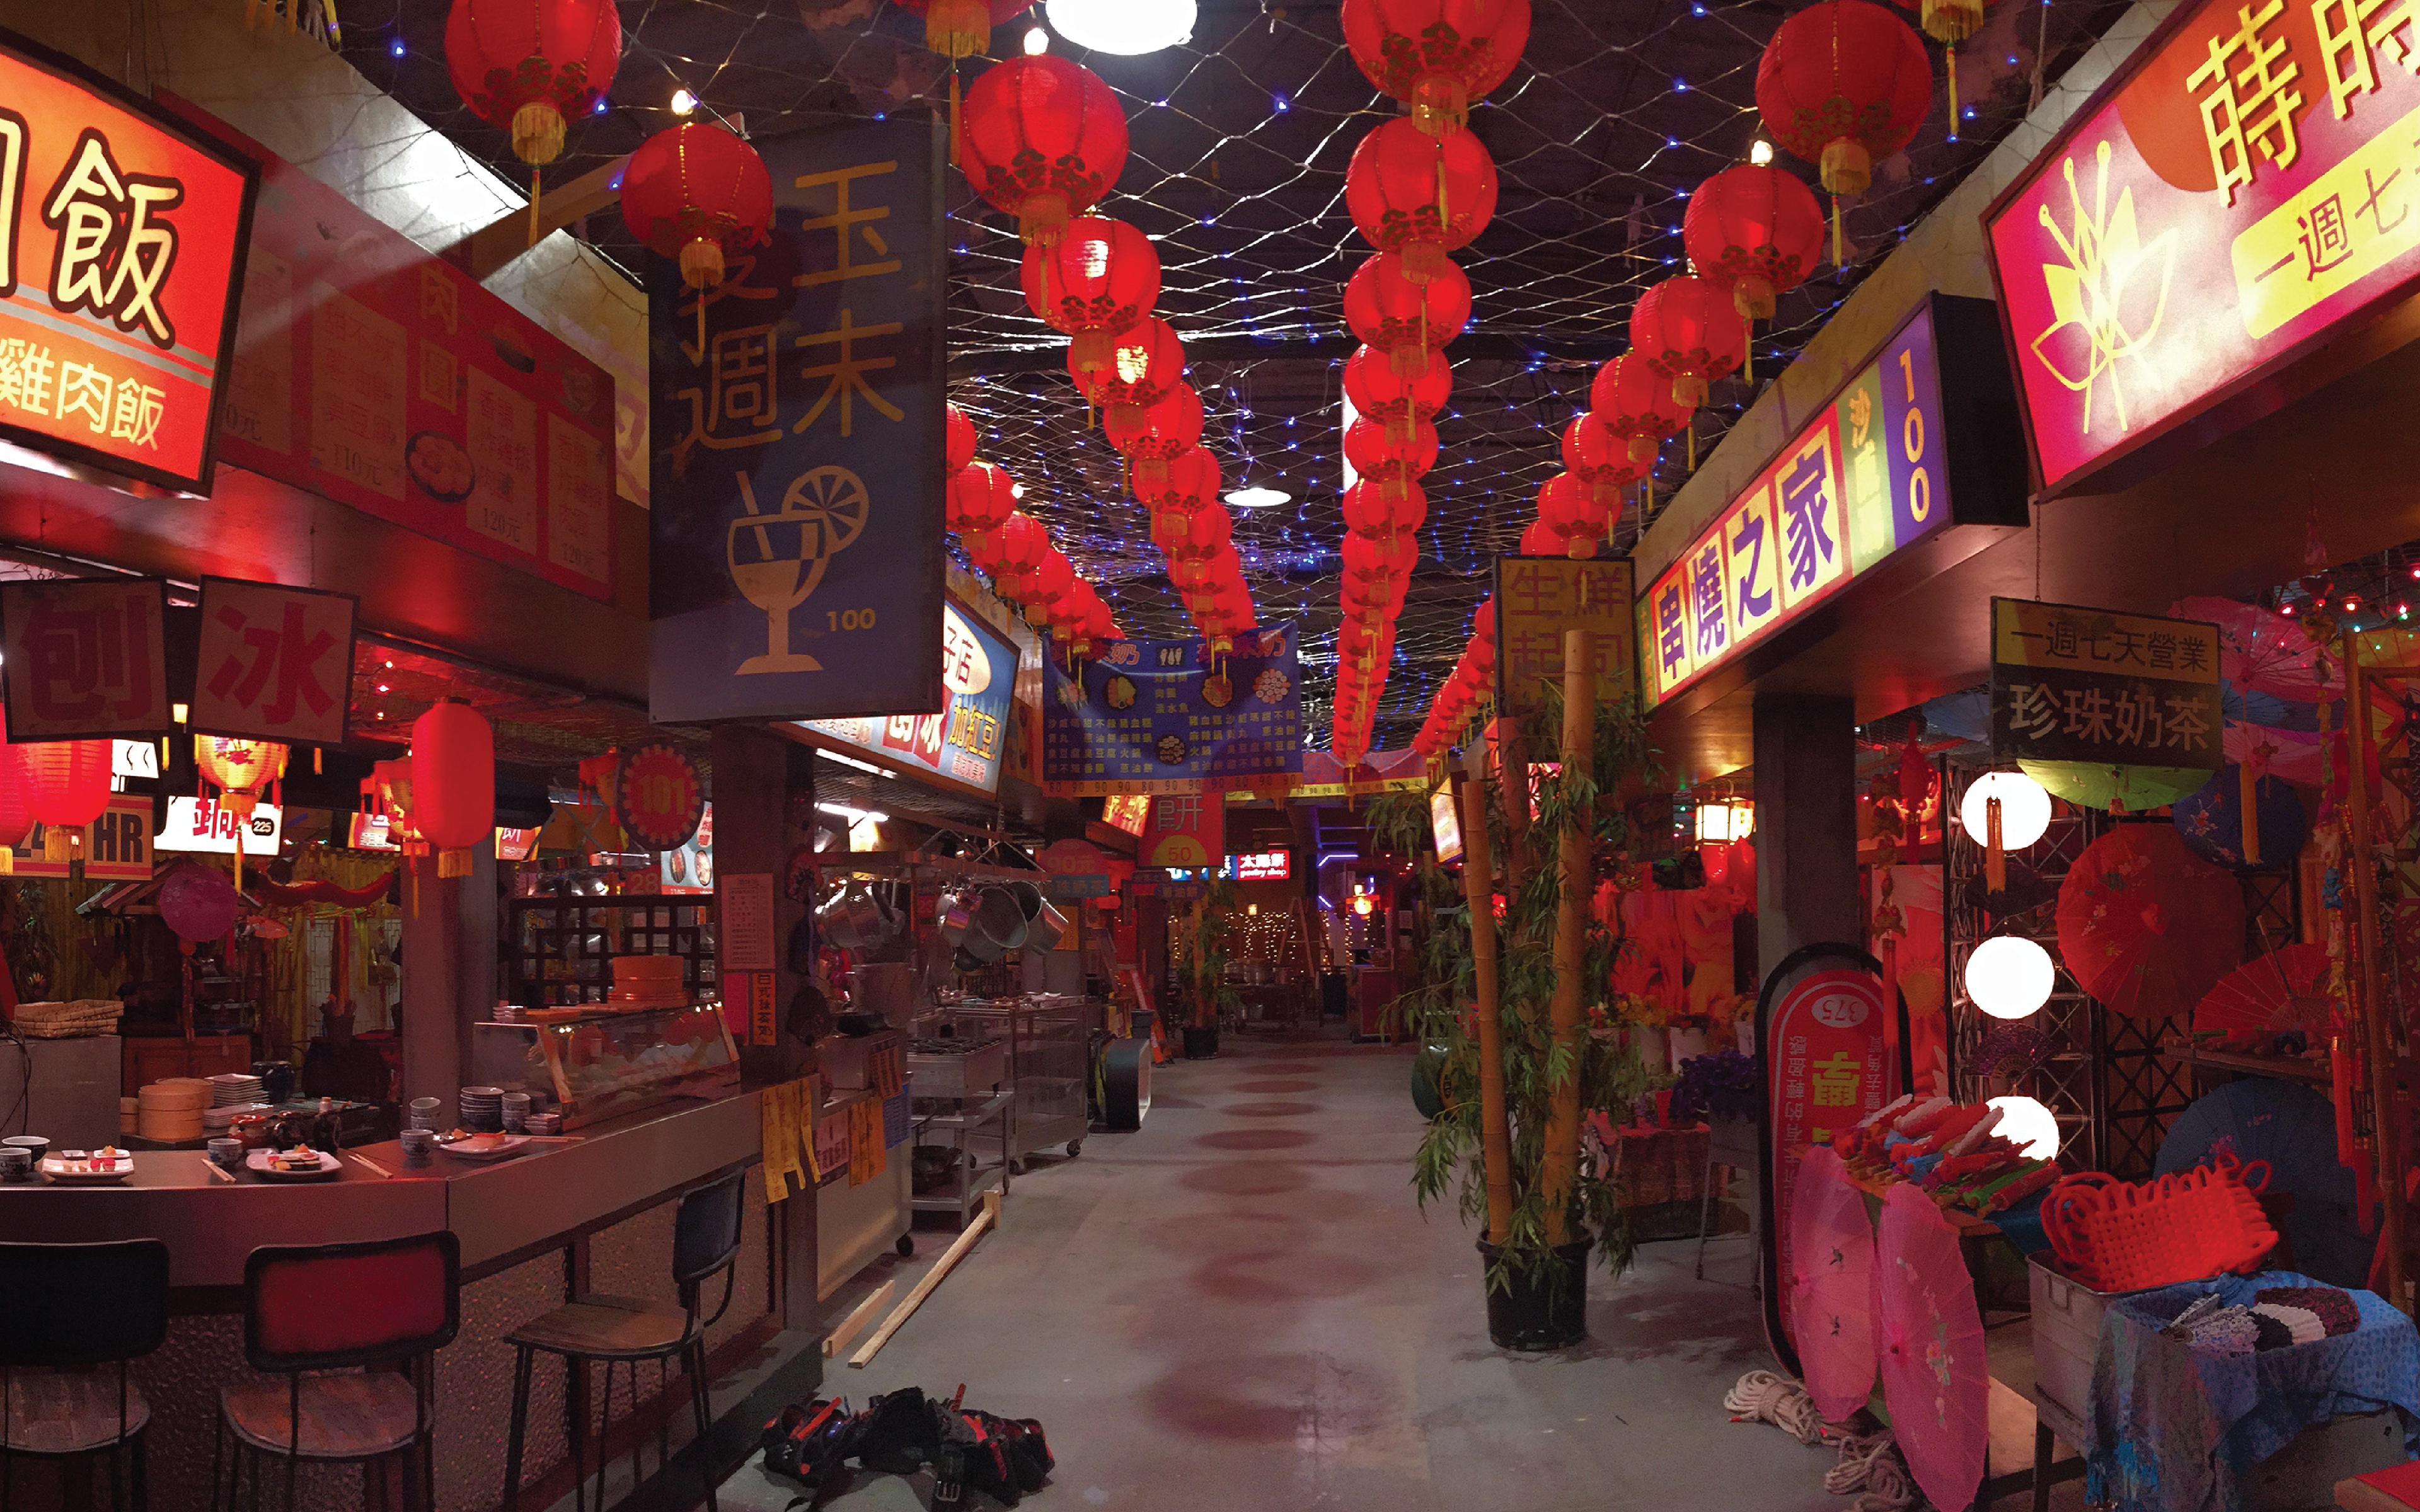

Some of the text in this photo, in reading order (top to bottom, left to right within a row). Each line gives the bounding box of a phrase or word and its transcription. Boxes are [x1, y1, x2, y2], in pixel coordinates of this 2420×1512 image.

[2255, 136, 2420, 282] 一週七
[0, 338, 166, 451] 雞肉飯
[668, 309, 905, 476] 週末
[1899, 348, 1930, 523] 100
[483, 507, 521, 542] 120元
[1659, 442, 1835, 682] 串燒之家
[827, 608, 876, 631] 100
[205, 603, 338, 724] 冰
[2010, 621, 2209, 673] 一週七天營業
[2010, 682, 2210, 752] 珍珠奶茶
[638, 774, 686, 815] 101
[1095, 781, 1108, 792] 90
[1118, 781, 1131, 792] 90
[1165, 780, 1178, 791] 90
[93, 813, 144, 862] HR
[253, 820, 272, 833] 225
[1168, 847, 1192, 862] 50
[1823, 999, 1858, 1022] 375
